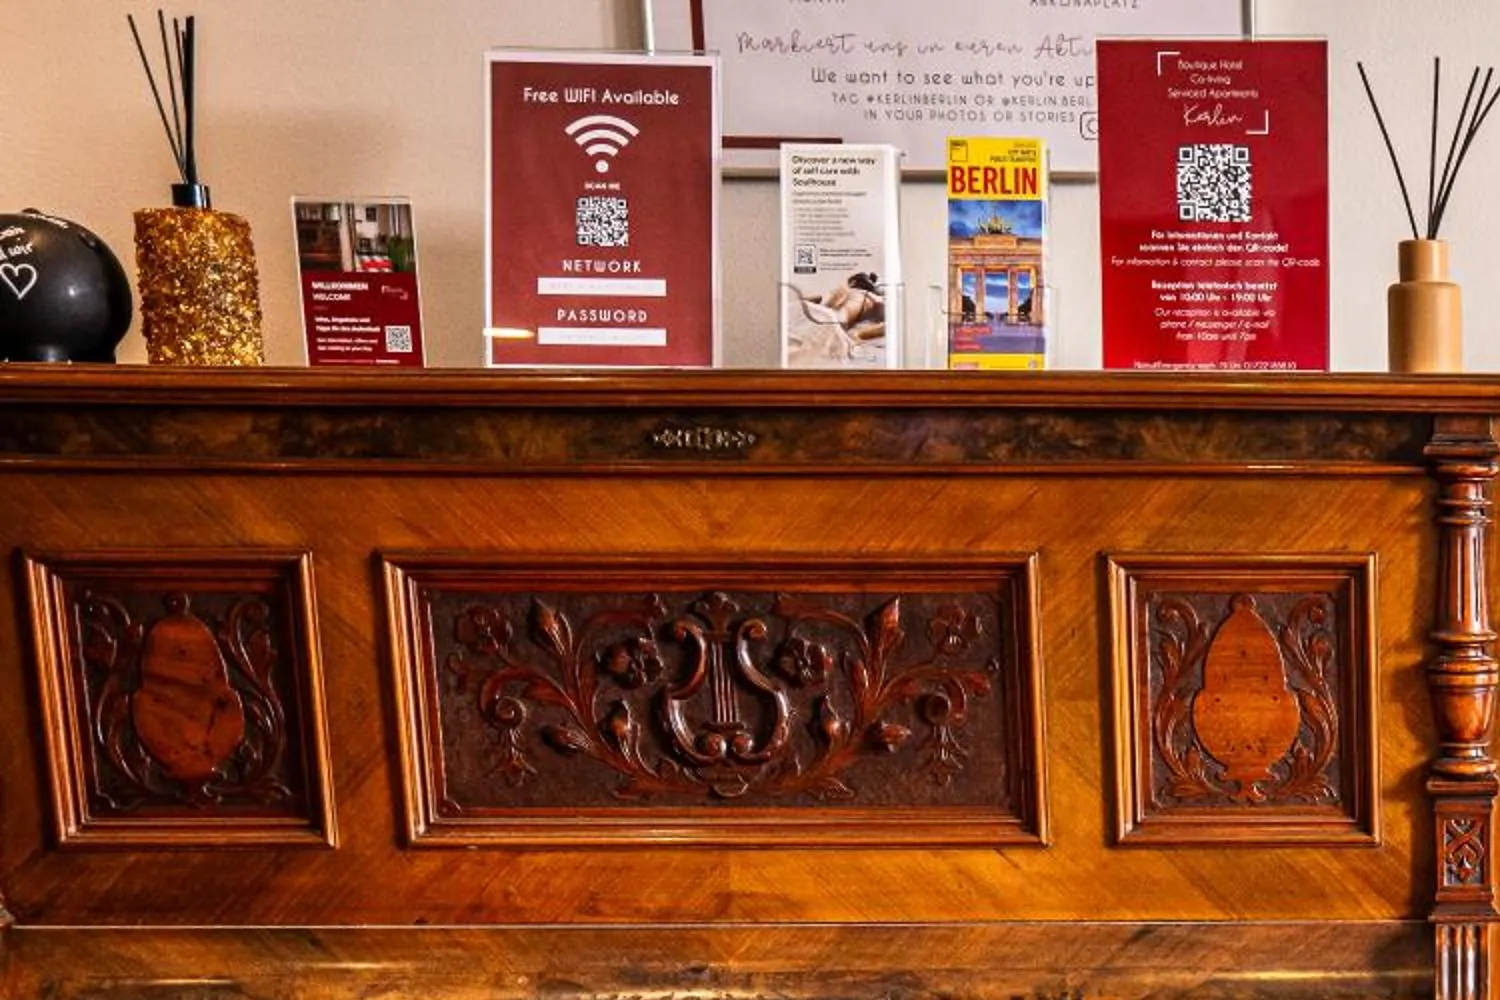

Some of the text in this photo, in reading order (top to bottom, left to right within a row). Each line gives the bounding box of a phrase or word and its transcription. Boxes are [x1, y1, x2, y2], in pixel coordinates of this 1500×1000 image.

[1219, 59, 1244, 70] Hotel
[811, 67, 1095, 88] We want to see what you're up
[523, 87, 680, 105] Free WIFI Available
[864, 109, 1076, 123] IN YOUR PHOTOS OR STORIES
[951, 165, 1037, 195] BERLIN
[562, 258, 642, 273] NETWORK
[557, 308, 648, 323] PASSWORD
